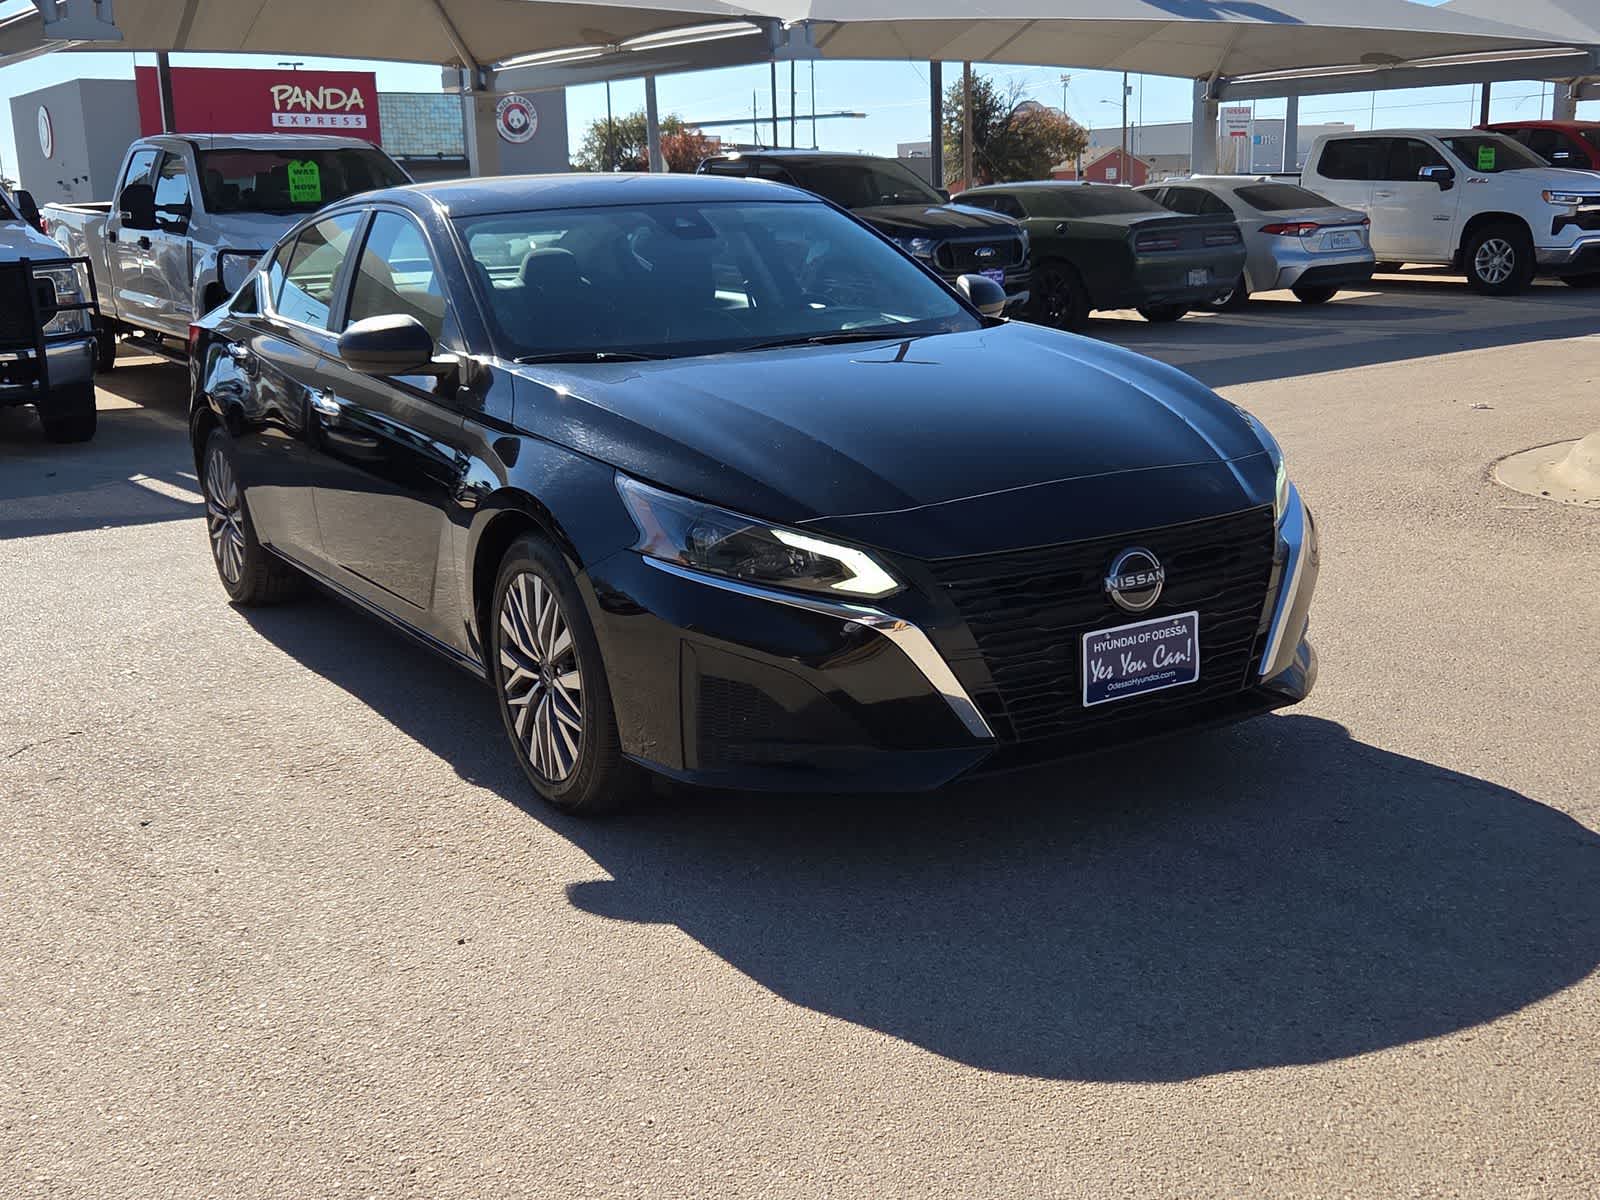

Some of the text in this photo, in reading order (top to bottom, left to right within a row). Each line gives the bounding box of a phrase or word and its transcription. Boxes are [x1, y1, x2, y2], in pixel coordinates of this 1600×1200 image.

[270, 84, 364, 111] PANDA
[277, 115, 362, 126] EXPRESS
[1104, 566, 1165, 591] NISSAN
[1093, 624, 1188, 653] HYUNDAI OF ODESSA
[1090, 637, 1192, 682] Yes You Can!
[1107, 670, 1176, 691] OdessaHyundai.com
